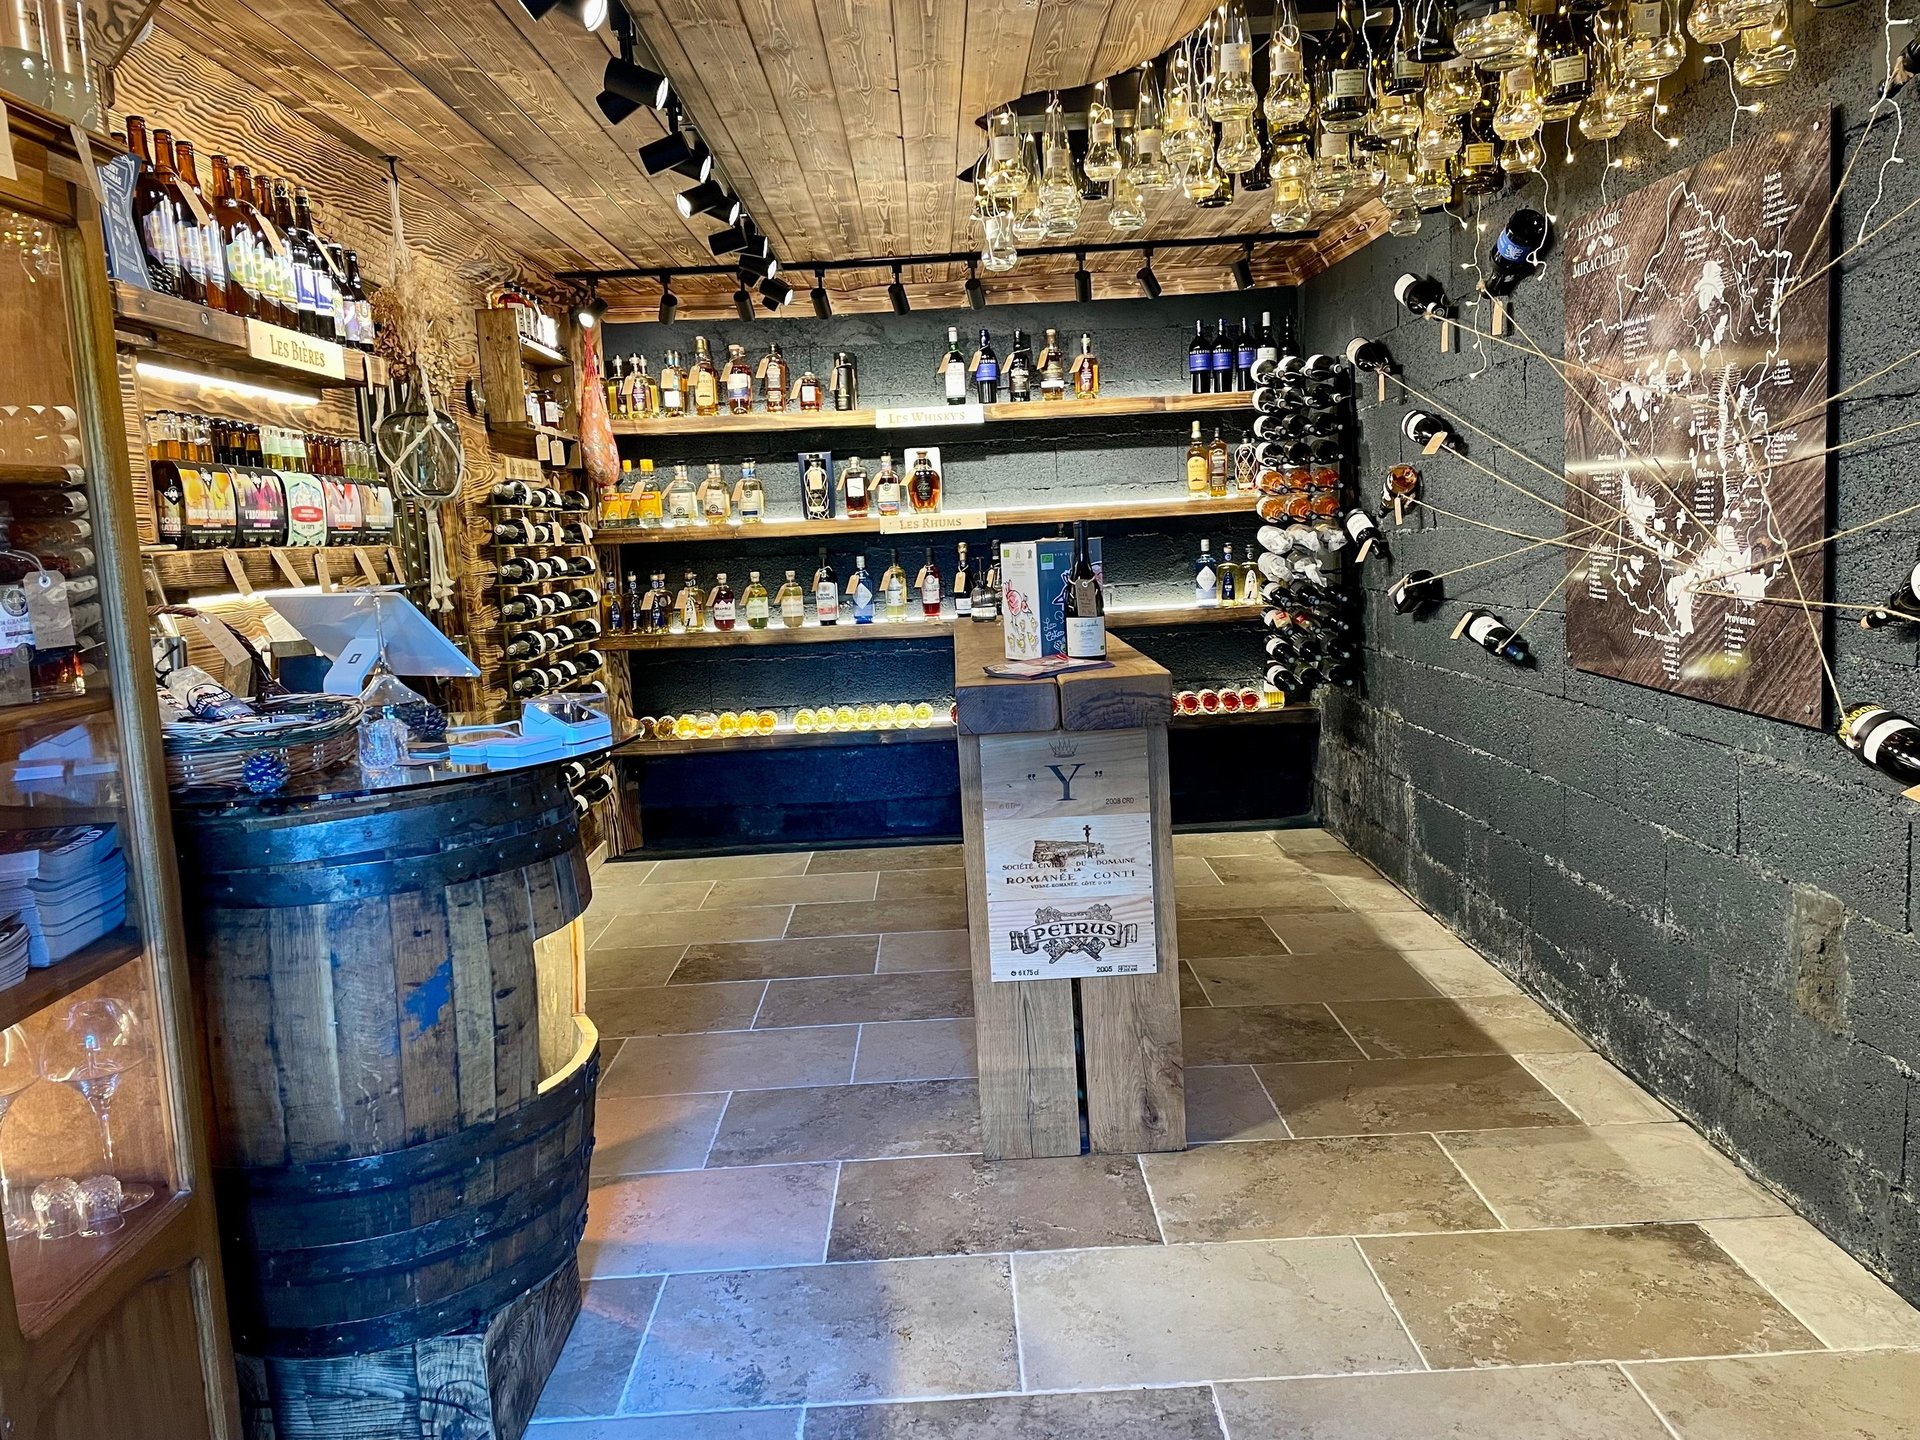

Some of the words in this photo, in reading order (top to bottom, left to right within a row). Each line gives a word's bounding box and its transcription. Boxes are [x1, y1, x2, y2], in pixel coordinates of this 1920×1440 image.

[1578, 208, 1623, 240] L'ALAMBIC
[1572, 244, 1629, 278] MIRACULEUX
[291, 340, 325, 368] BIÈRES
[922, 518, 962, 528] RHUMS
[1724, 612, 1756, 626] Provence
[1002, 862, 1034, 870] SOCIÉTÉ
[1096, 858, 1136, 866] DOMAINE
[1006, 873, 1076, 884] ROMANÉE
[1094, 870, 1135, 880] CONTI
[1030, 922, 1116, 940] PETRUS
